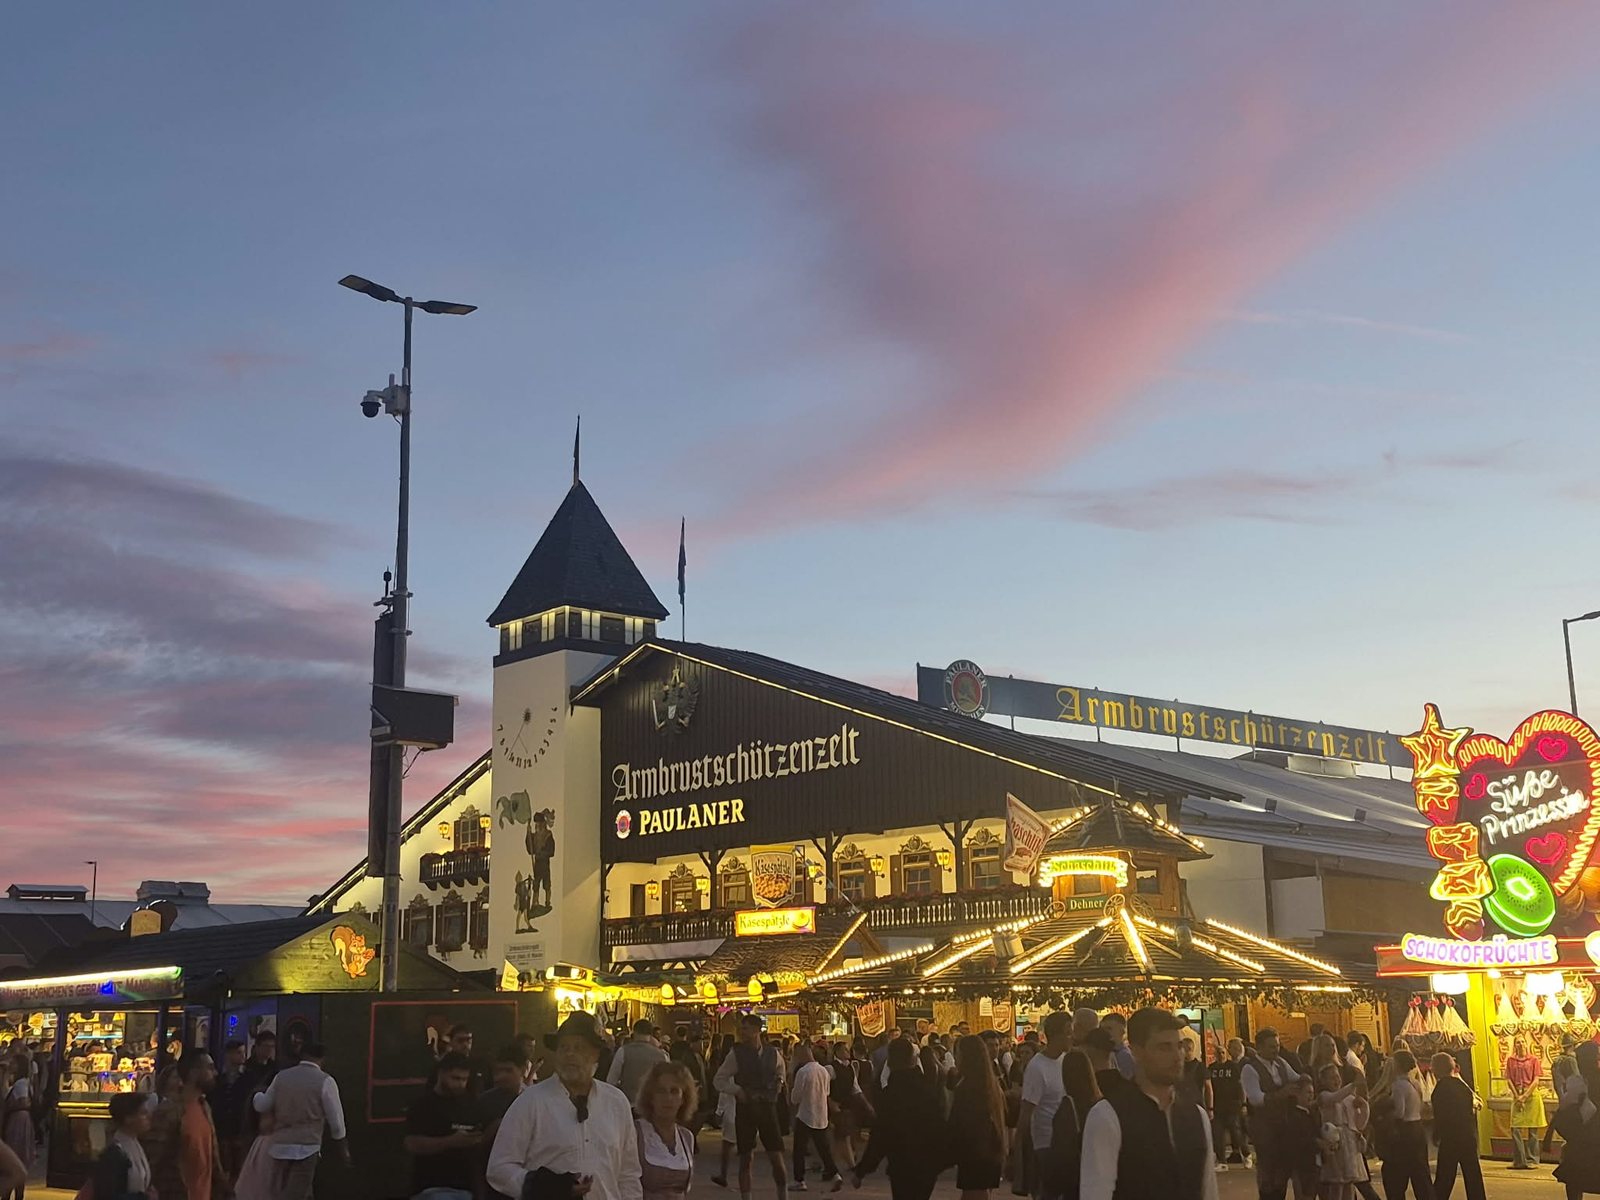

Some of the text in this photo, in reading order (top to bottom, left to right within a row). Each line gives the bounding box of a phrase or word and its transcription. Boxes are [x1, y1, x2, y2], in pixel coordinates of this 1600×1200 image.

[945, 661, 988, 689] PAULANER
[1056, 687, 1386, 763] Armbrustschützenzelt
[612, 722, 861, 804] Armbrustschützenzelt
[1487, 769, 1560, 813] Süße
[639, 799, 745, 836] PAULANER
[1480, 785, 1590, 845] Prinzessin
[1070, 899, 1104, 909] Dehner
[1405, 938, 1552, 963] SCHOKOFRÜCHTE
